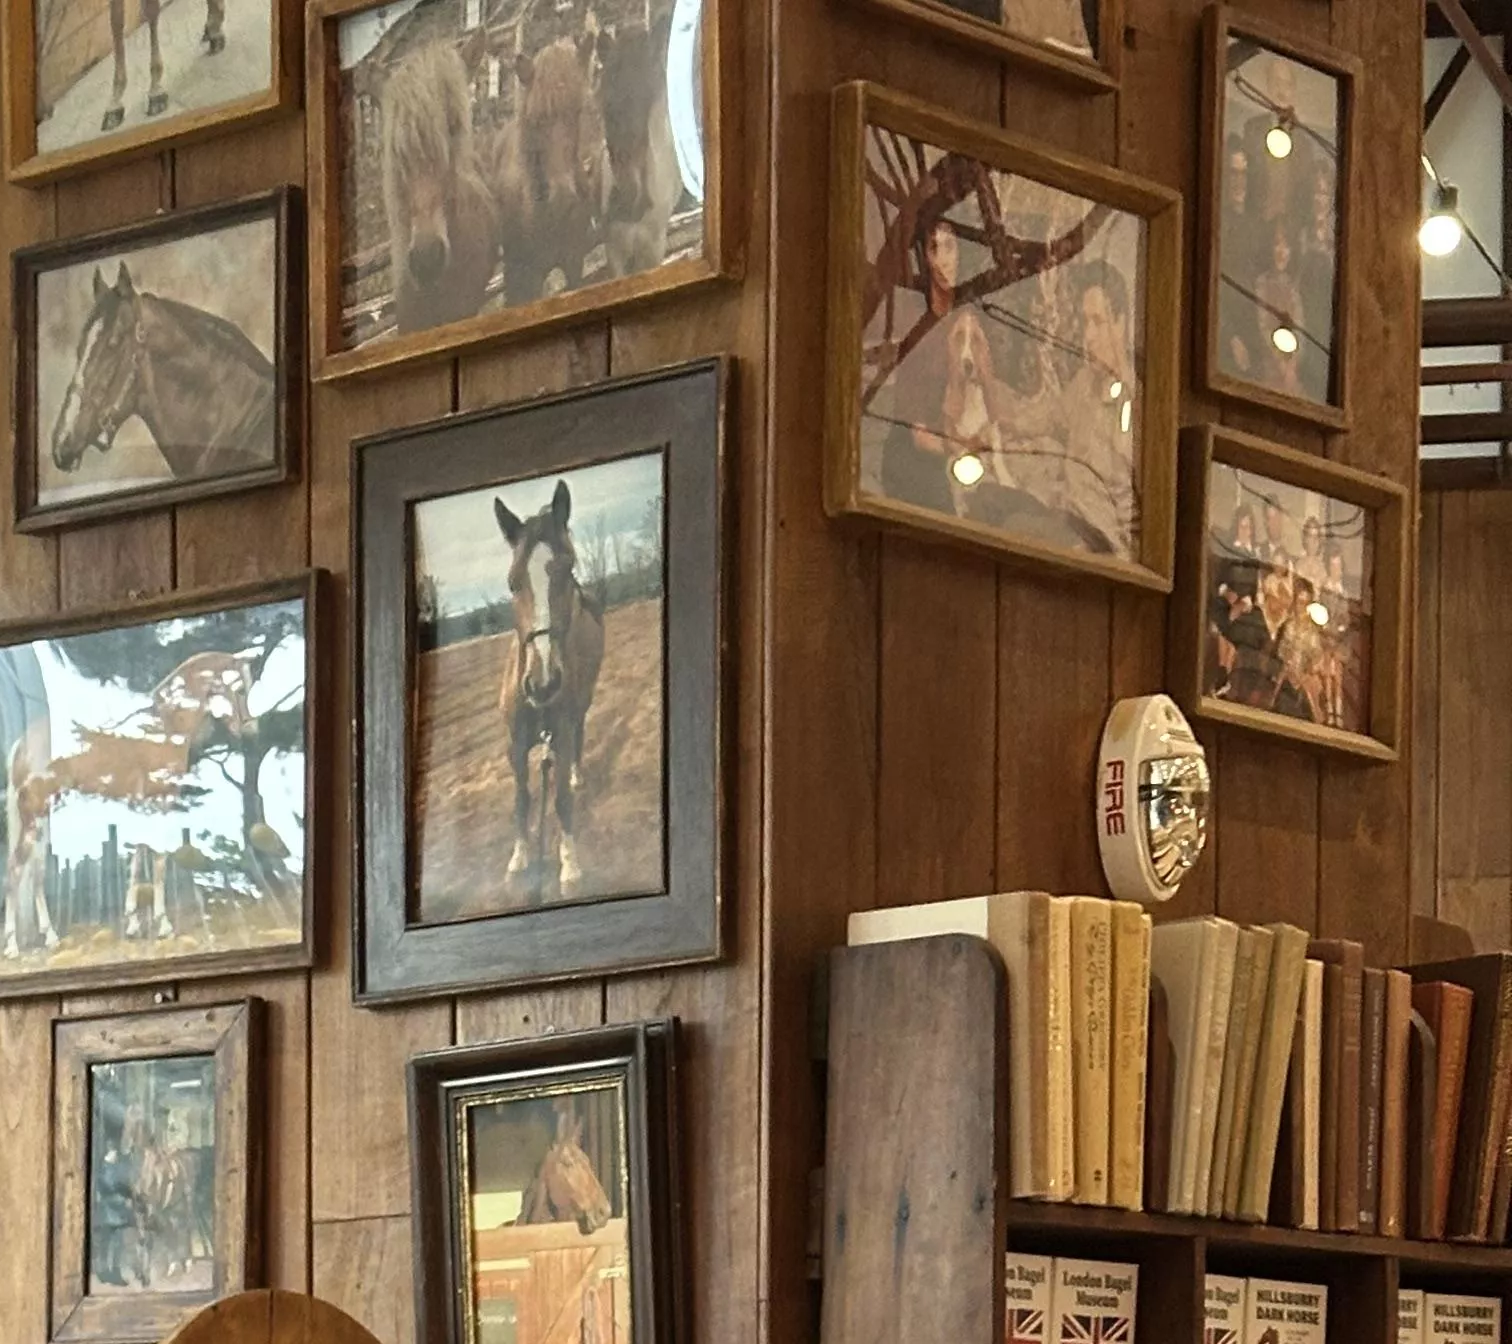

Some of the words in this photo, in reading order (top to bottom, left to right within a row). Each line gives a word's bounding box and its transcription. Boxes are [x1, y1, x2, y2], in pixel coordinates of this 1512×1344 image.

[1105, 760, 1126, 836] FIRE
[1063, 1270, 1102, 1288] London
[1104, 1274, 1133, 1295] Bagel
[1076, 1290, 1119, 1308] Museum
[1256, 1289, 1321, 1308] HILLSBURRY
[1256, 1306, 1284, 1321] DARK
[1286, 1310, 1320, 1326] HORSE
